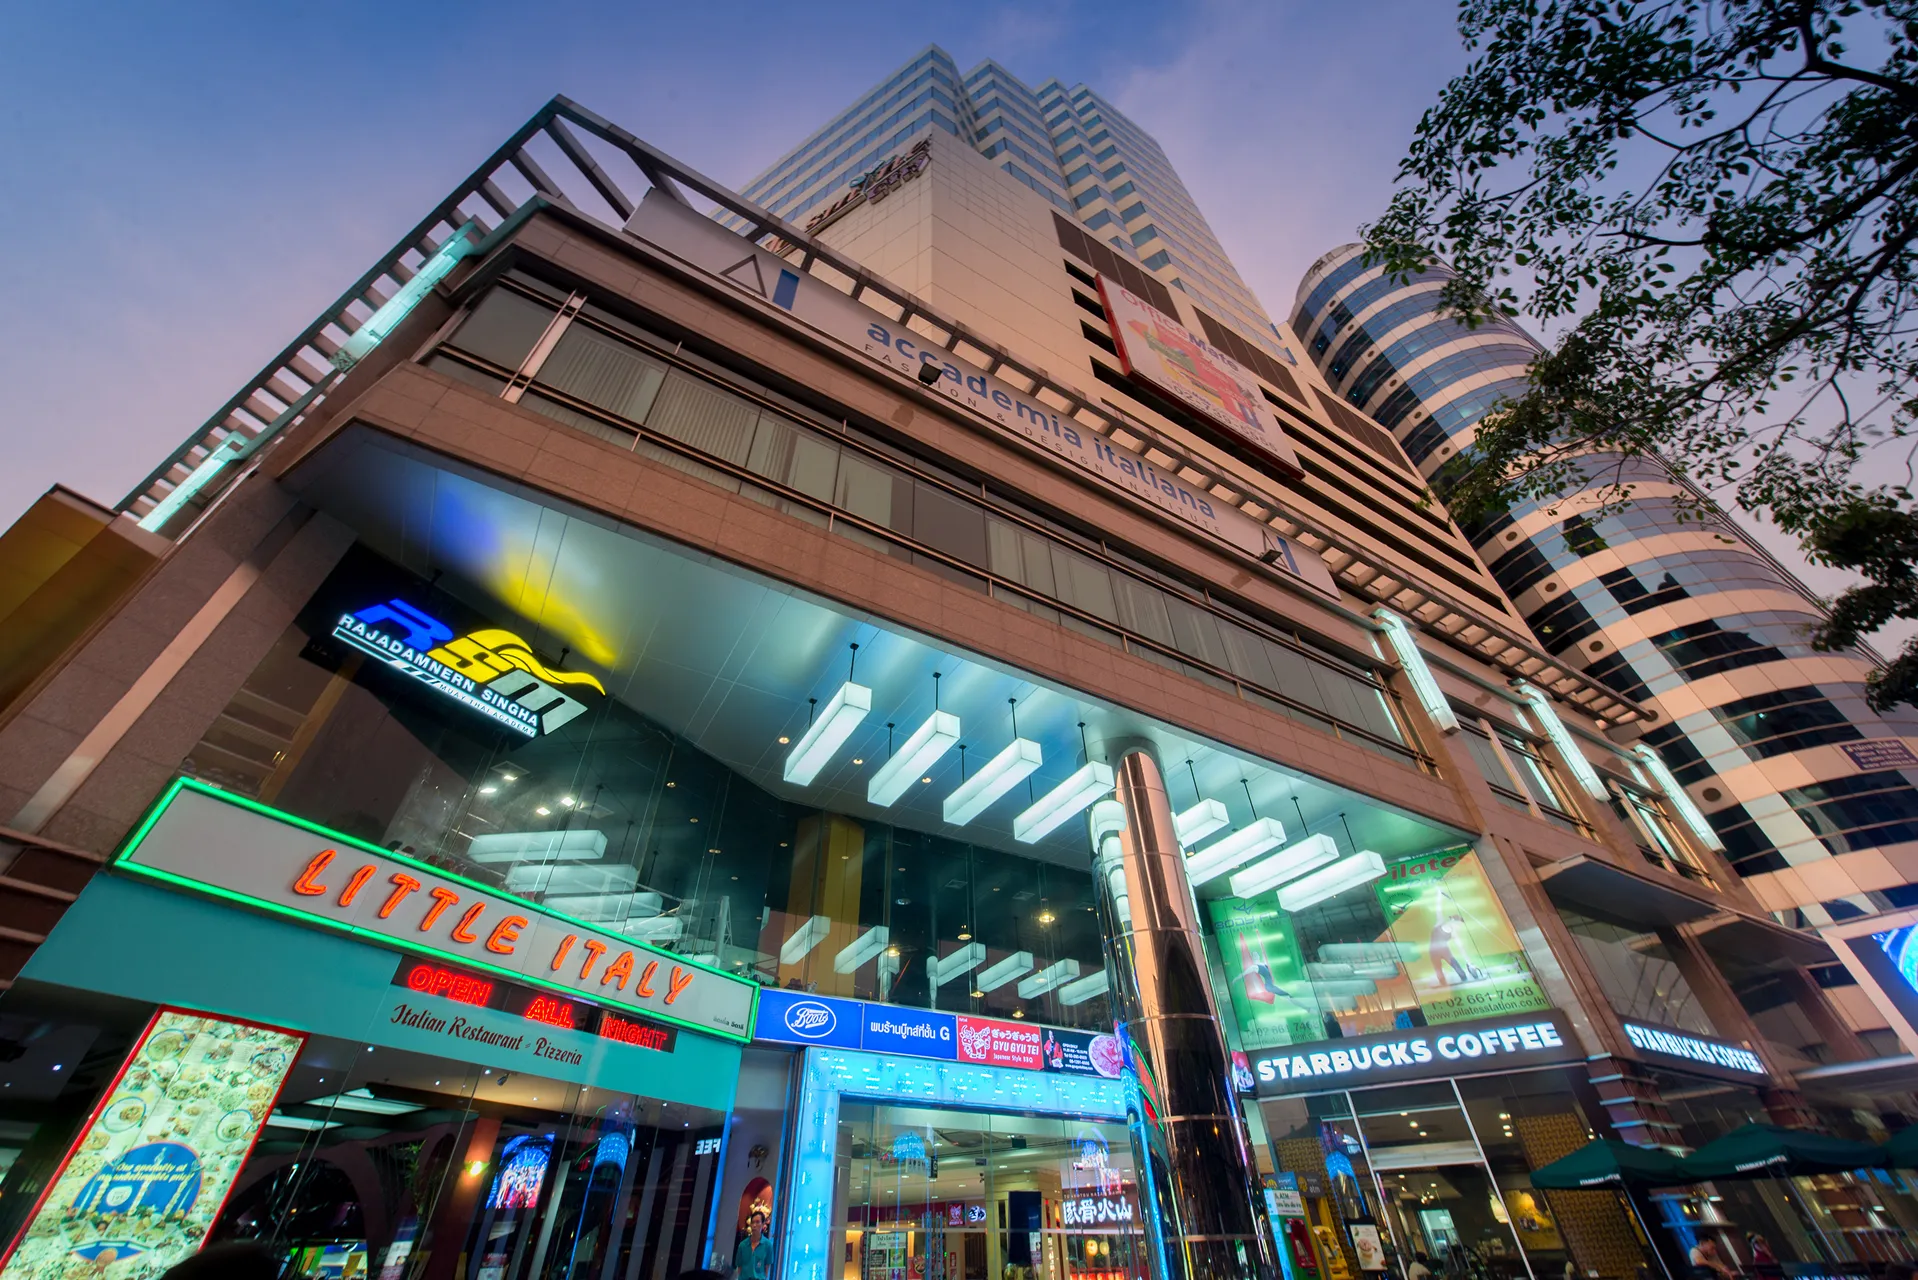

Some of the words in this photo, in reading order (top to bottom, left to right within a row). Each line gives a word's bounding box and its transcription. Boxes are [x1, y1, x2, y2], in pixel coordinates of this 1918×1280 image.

[1120, 289, 1239, 372] OfficeMate
[864, 343, 977, 408] FASION
[996, 412, 1006, 423] &
[1024, 426, 1104, 474] DESIGN
[1119, 476, 1221, 534] INSTITUTE
[867, 322, 1083, 449] accademia
[1093, 437, 1216, 520] italiana
[338, 613, 477, 693] RAJADAMNERN
[481, 689, 538, 728] SINGHA
[438, 683, 468, 701] MUAY
[469, 698, 491, 715] THAI
[491, 711, 537, 738] ACADEMY
[293, 848, 529, 955] LITTLE
[552, 934, 694, 1005] ITALY
[407, 965, 493, 1008] OPEN
[526, 995, 575, 1030] ALL
[600, 1016, 668, 1053] NIGHT
[791, 1007, 829, 1029] Boots
[1427, 996, 1546, 1021] www.pilatesstation.co.th
[1445, 997, 1465, 1008] 02
[1466, 992, 1493, 1004] 661
[1496, 986, 1534, 999] 7468
[390, 1004, 445, 1034] Italian
[447, 1015, 524, 1051] Restaurant
[532, 1037, 583, 1066] Pizzeria
[939, 1026, 950, 1041] G
[992, 1040, 1010, 1052] GYU
[1010, 1042, 1026, 1054] GYU
[1027, 1044, 1039, 1055] TEI
[993, 1053, 1011, 1061] Japanese
[1011, 1055, 1022, 1063] Style
[1257, 1039, 1433, 1082] STARBUCKS
[1437, 1022, 1564, 1060] COFFEE
[1623, 1022, 1712, 1066] STARBUCKS
[1709, 1042, 1764, 1074] COFFEE
